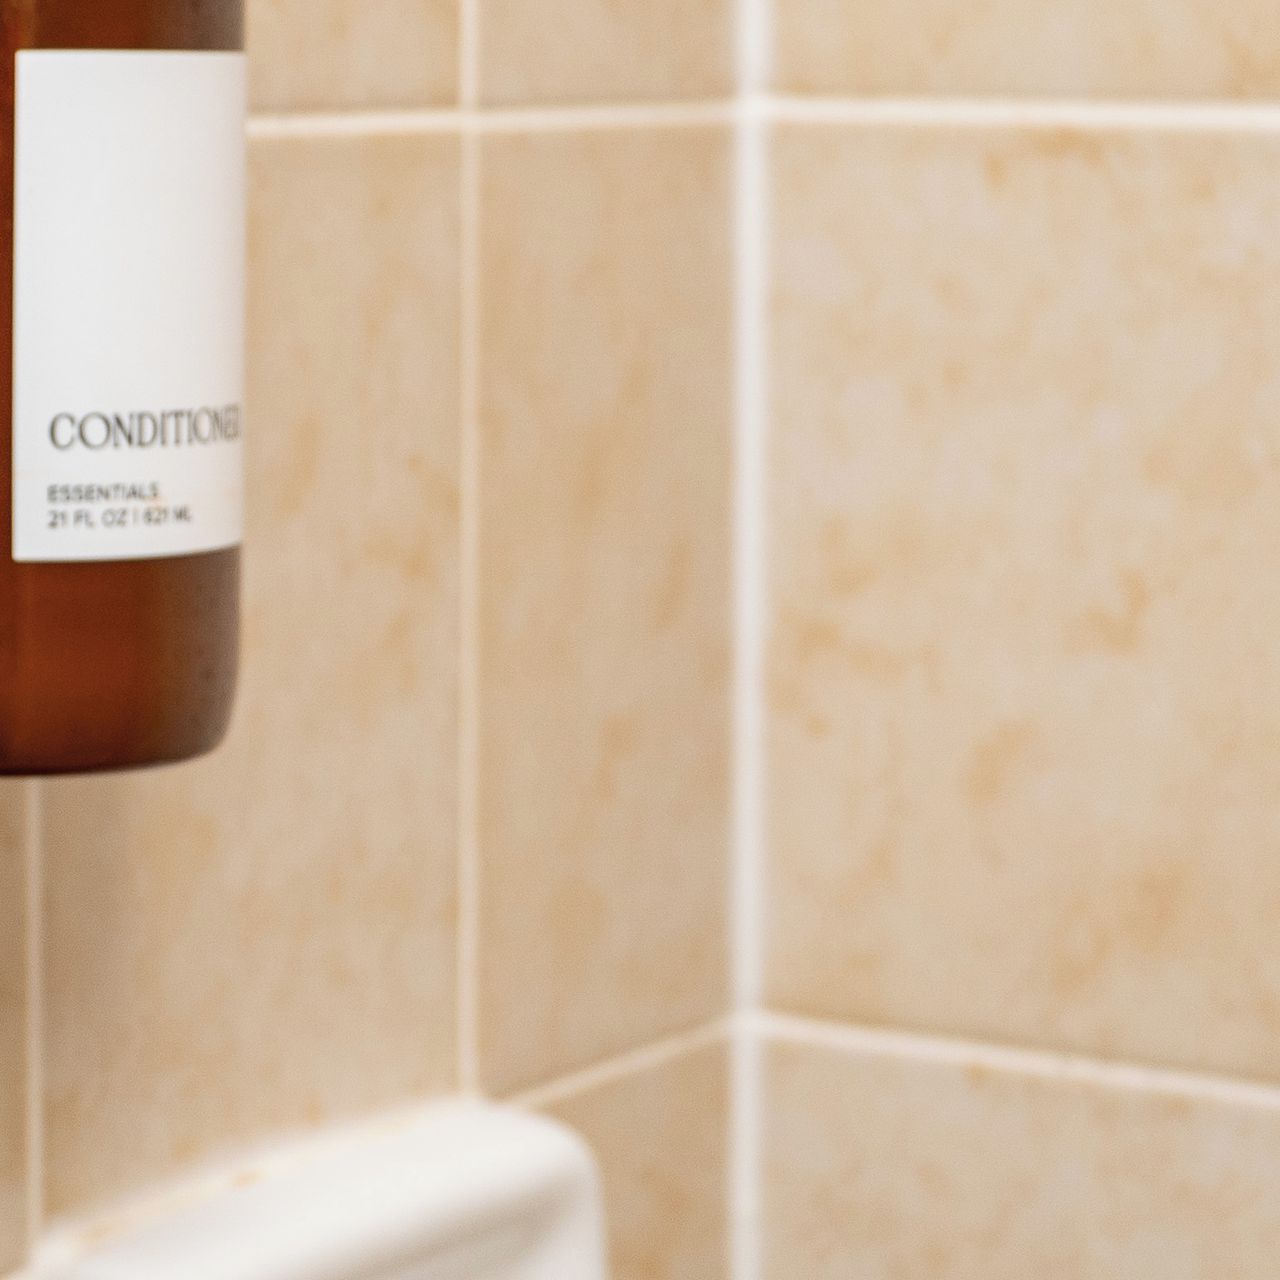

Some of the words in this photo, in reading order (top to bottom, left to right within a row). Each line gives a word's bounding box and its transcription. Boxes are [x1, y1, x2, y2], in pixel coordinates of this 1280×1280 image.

[49, 403, 239, 450] CONDITIONE
[47, 482, 160, 504] ESSENTIALS
[48, 510, 67, 529] 21
[73, 510, 94, 528] FL
[102, 509, 128, 527] OZ
